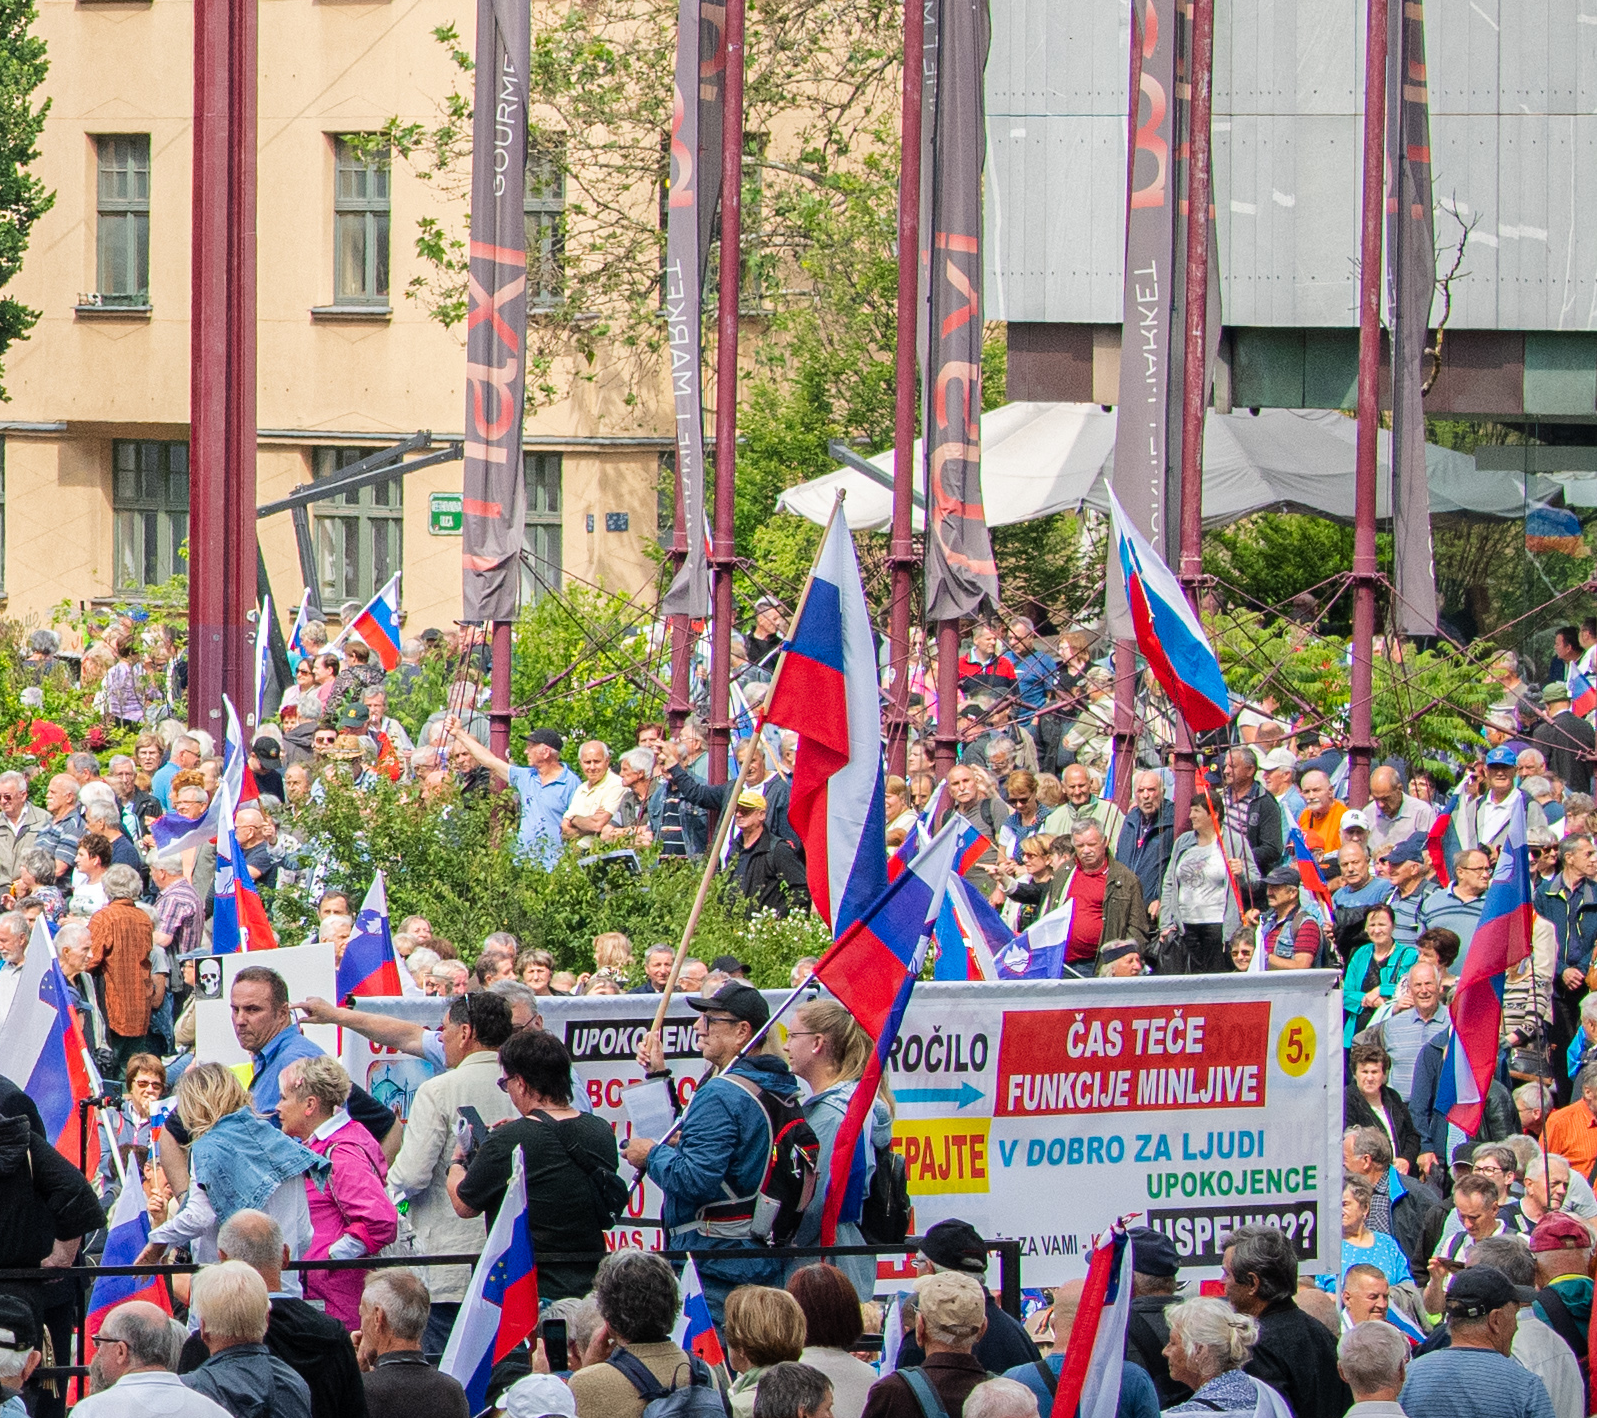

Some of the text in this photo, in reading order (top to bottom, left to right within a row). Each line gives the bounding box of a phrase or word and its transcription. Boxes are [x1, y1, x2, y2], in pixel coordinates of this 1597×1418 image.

[1066, 1011, 1124, 1059] ČAS
[1132, 1008, 1206, 1056] TEČE
[1285, 1026, 1312, 1066] 5.
[1007, 1063, 1260, 1113] FUNKCIJE MINLJIVE
[998, 1139, 1018, 1168] V
[1026, 1135, 1126, 1168] DOBRO
[1134, 1133, 1172, 1163] ZA
[1182, 1129, 1266, 1161] LJUDI
[1146, 1165, 1318, 1200] UPOKOJENCE
[1041, 1234, 1079, 1256] VAMI
